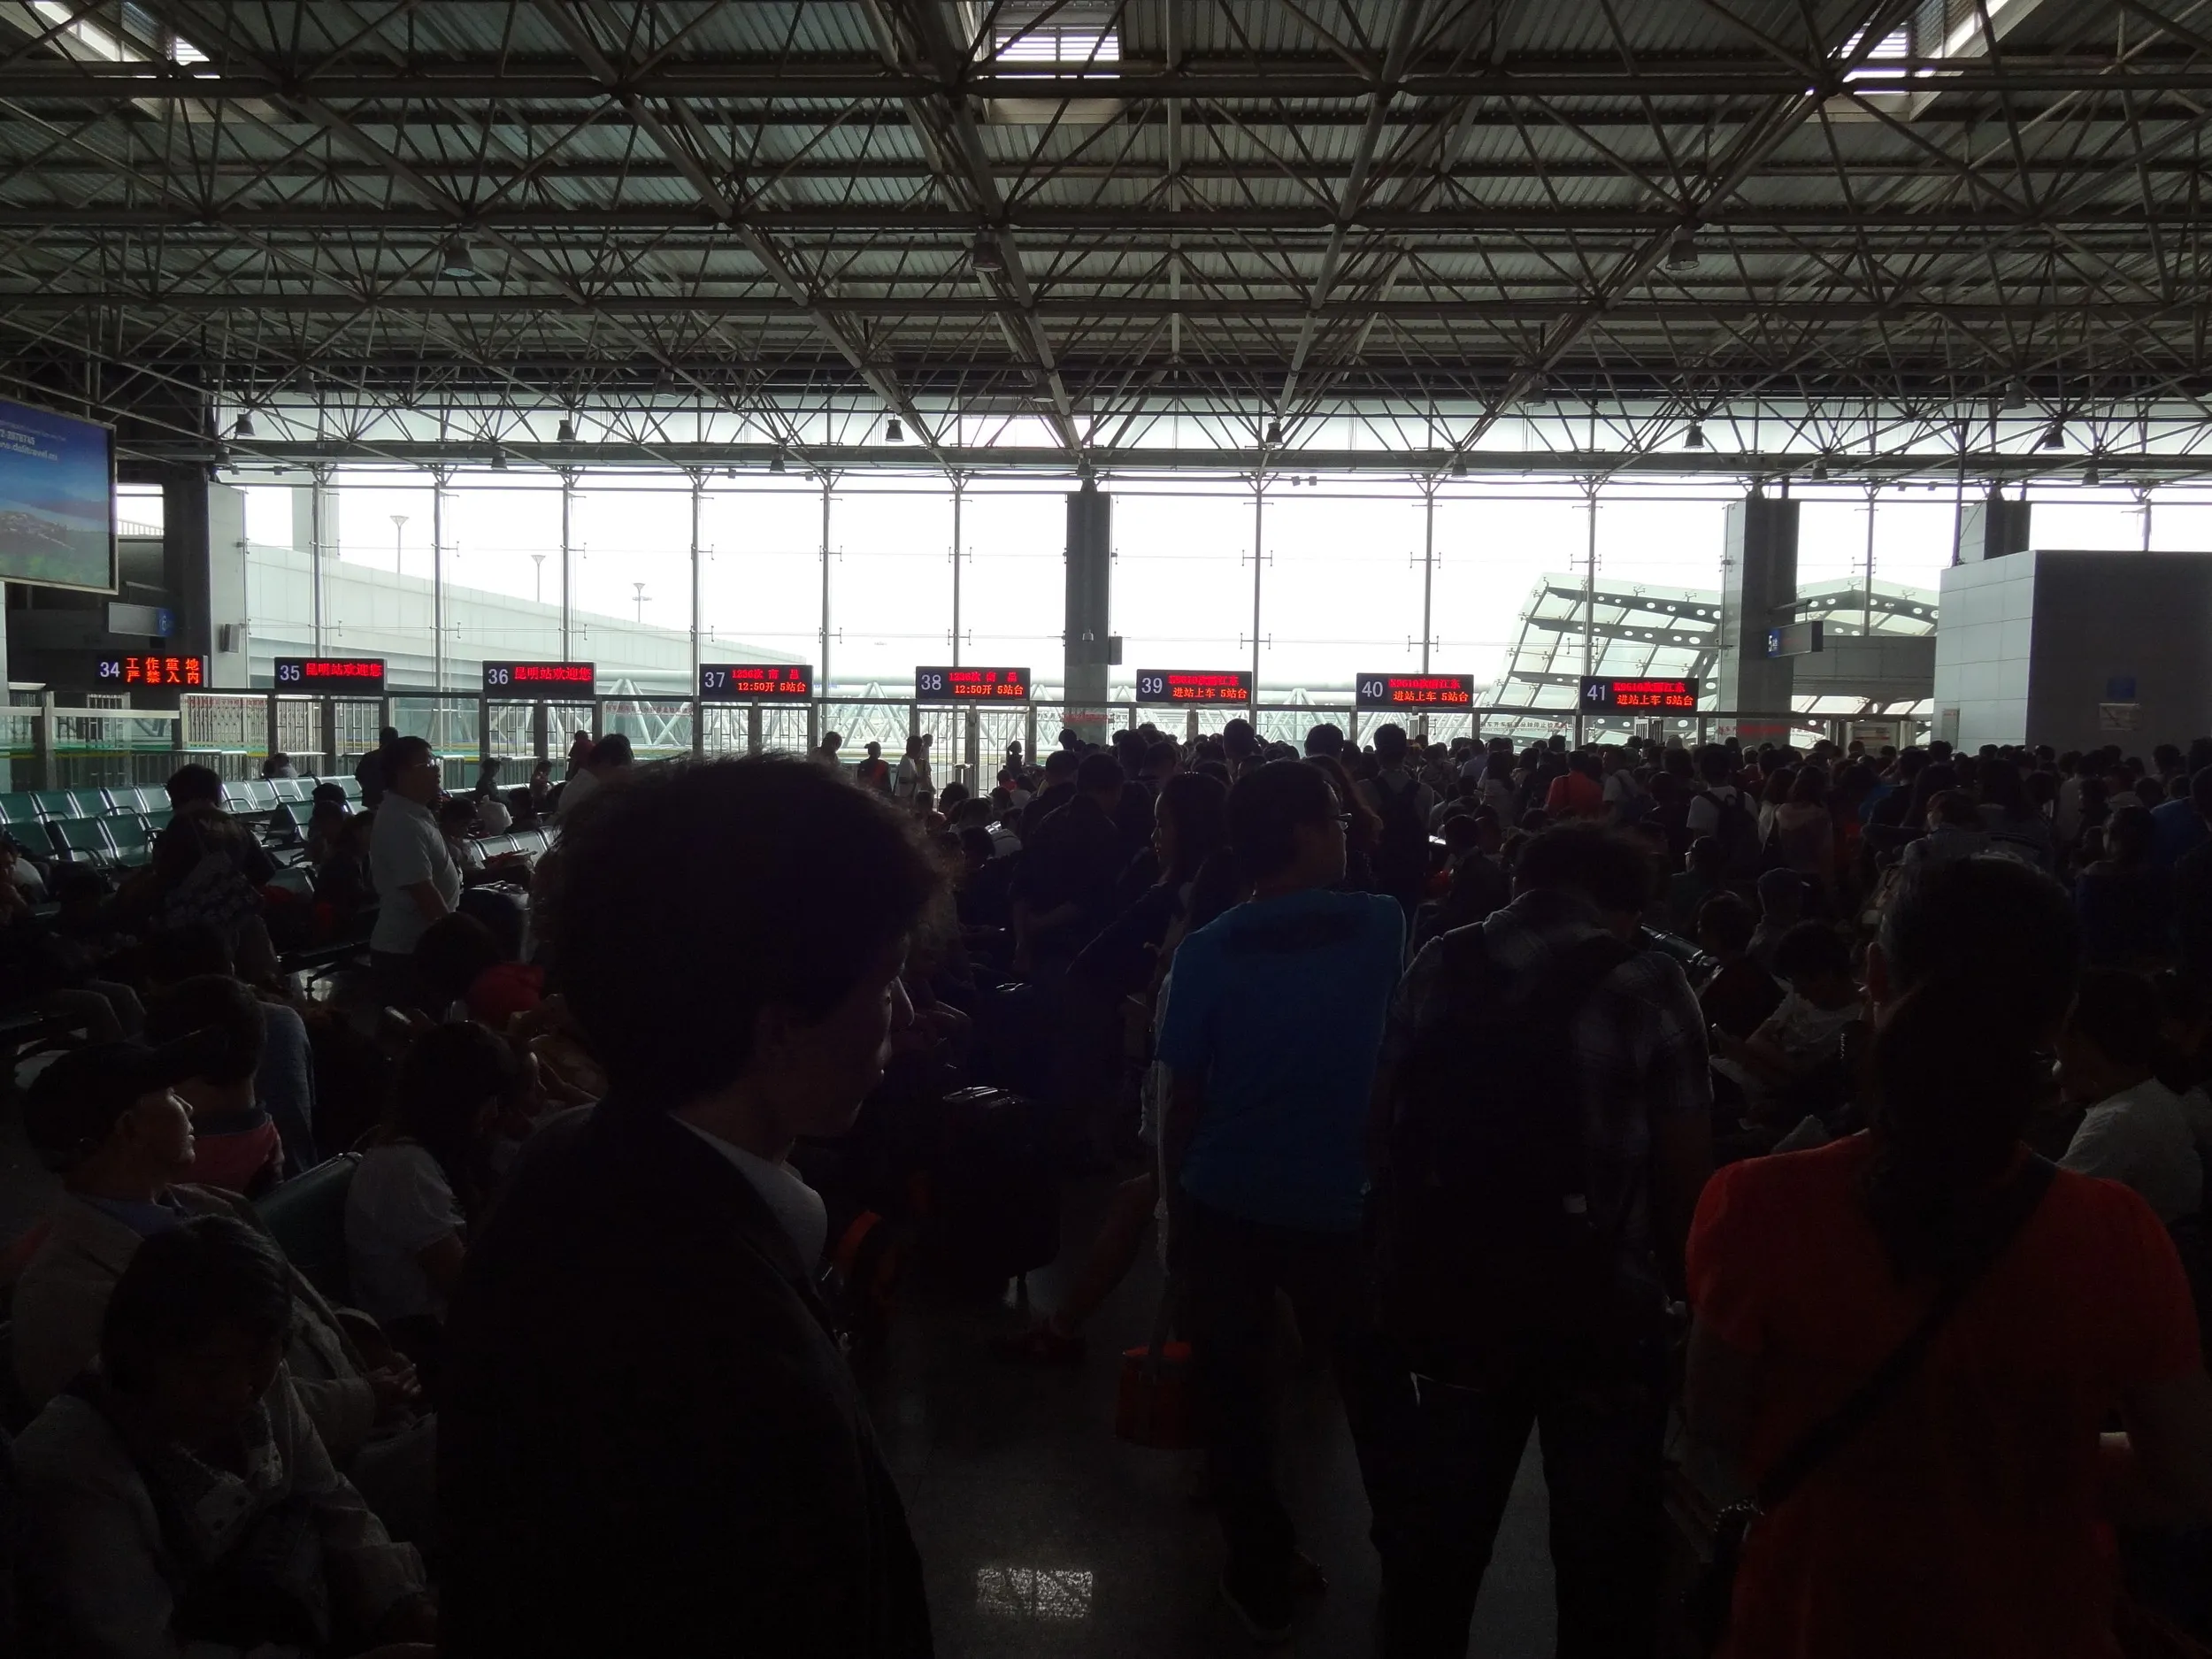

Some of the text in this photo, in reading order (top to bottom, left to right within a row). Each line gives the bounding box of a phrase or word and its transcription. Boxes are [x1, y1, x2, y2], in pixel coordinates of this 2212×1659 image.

[100, 662, 120, 678] 34
[126, 657, 200, 671] 工作重地
[306, 663, 382, 677] 昆明站欢迎您
[127, 670, 202, 684] 严禁入内
[280, 665, 300, 680] 35
[488, 669, 508, 684] 36
[514, 666, 592, 680] 昆明站欢迎您
[704, 672, 725, 687] 37
[921, 674, 941, 690] 38
[1141, 678, 1163, 694] 39
[1362, 681, 1383, 697] 40
[1586, 685, 1606, 701] 41
